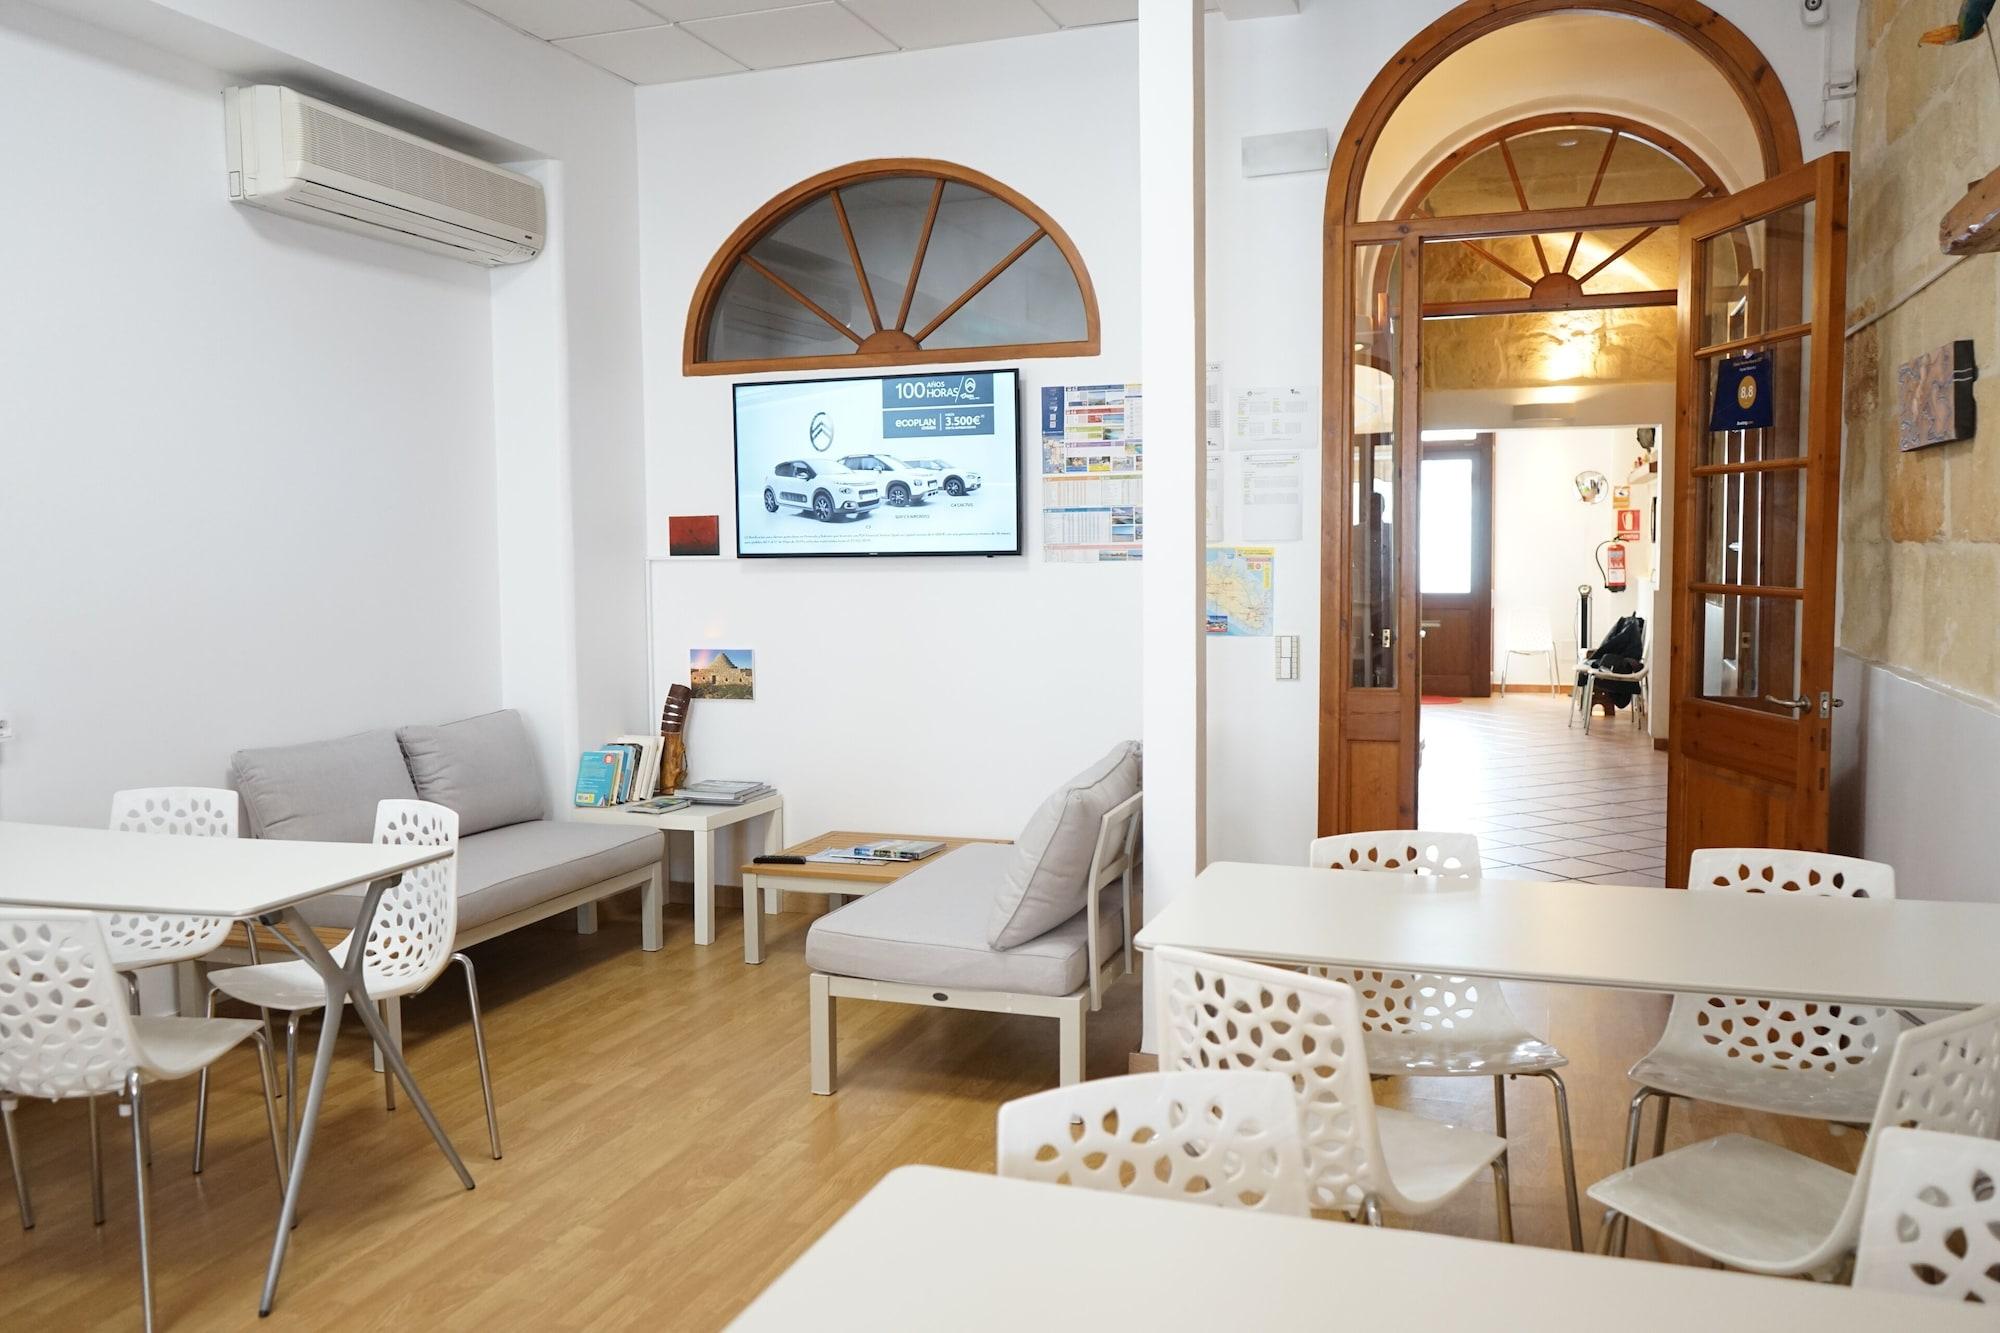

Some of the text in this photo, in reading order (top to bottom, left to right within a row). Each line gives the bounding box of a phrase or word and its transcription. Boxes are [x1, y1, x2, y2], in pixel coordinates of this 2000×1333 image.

[895, 382, 925, 399] 100
[926, 387, 959, 398] HORAS
[945, 415, 981, 426] 3.500€
